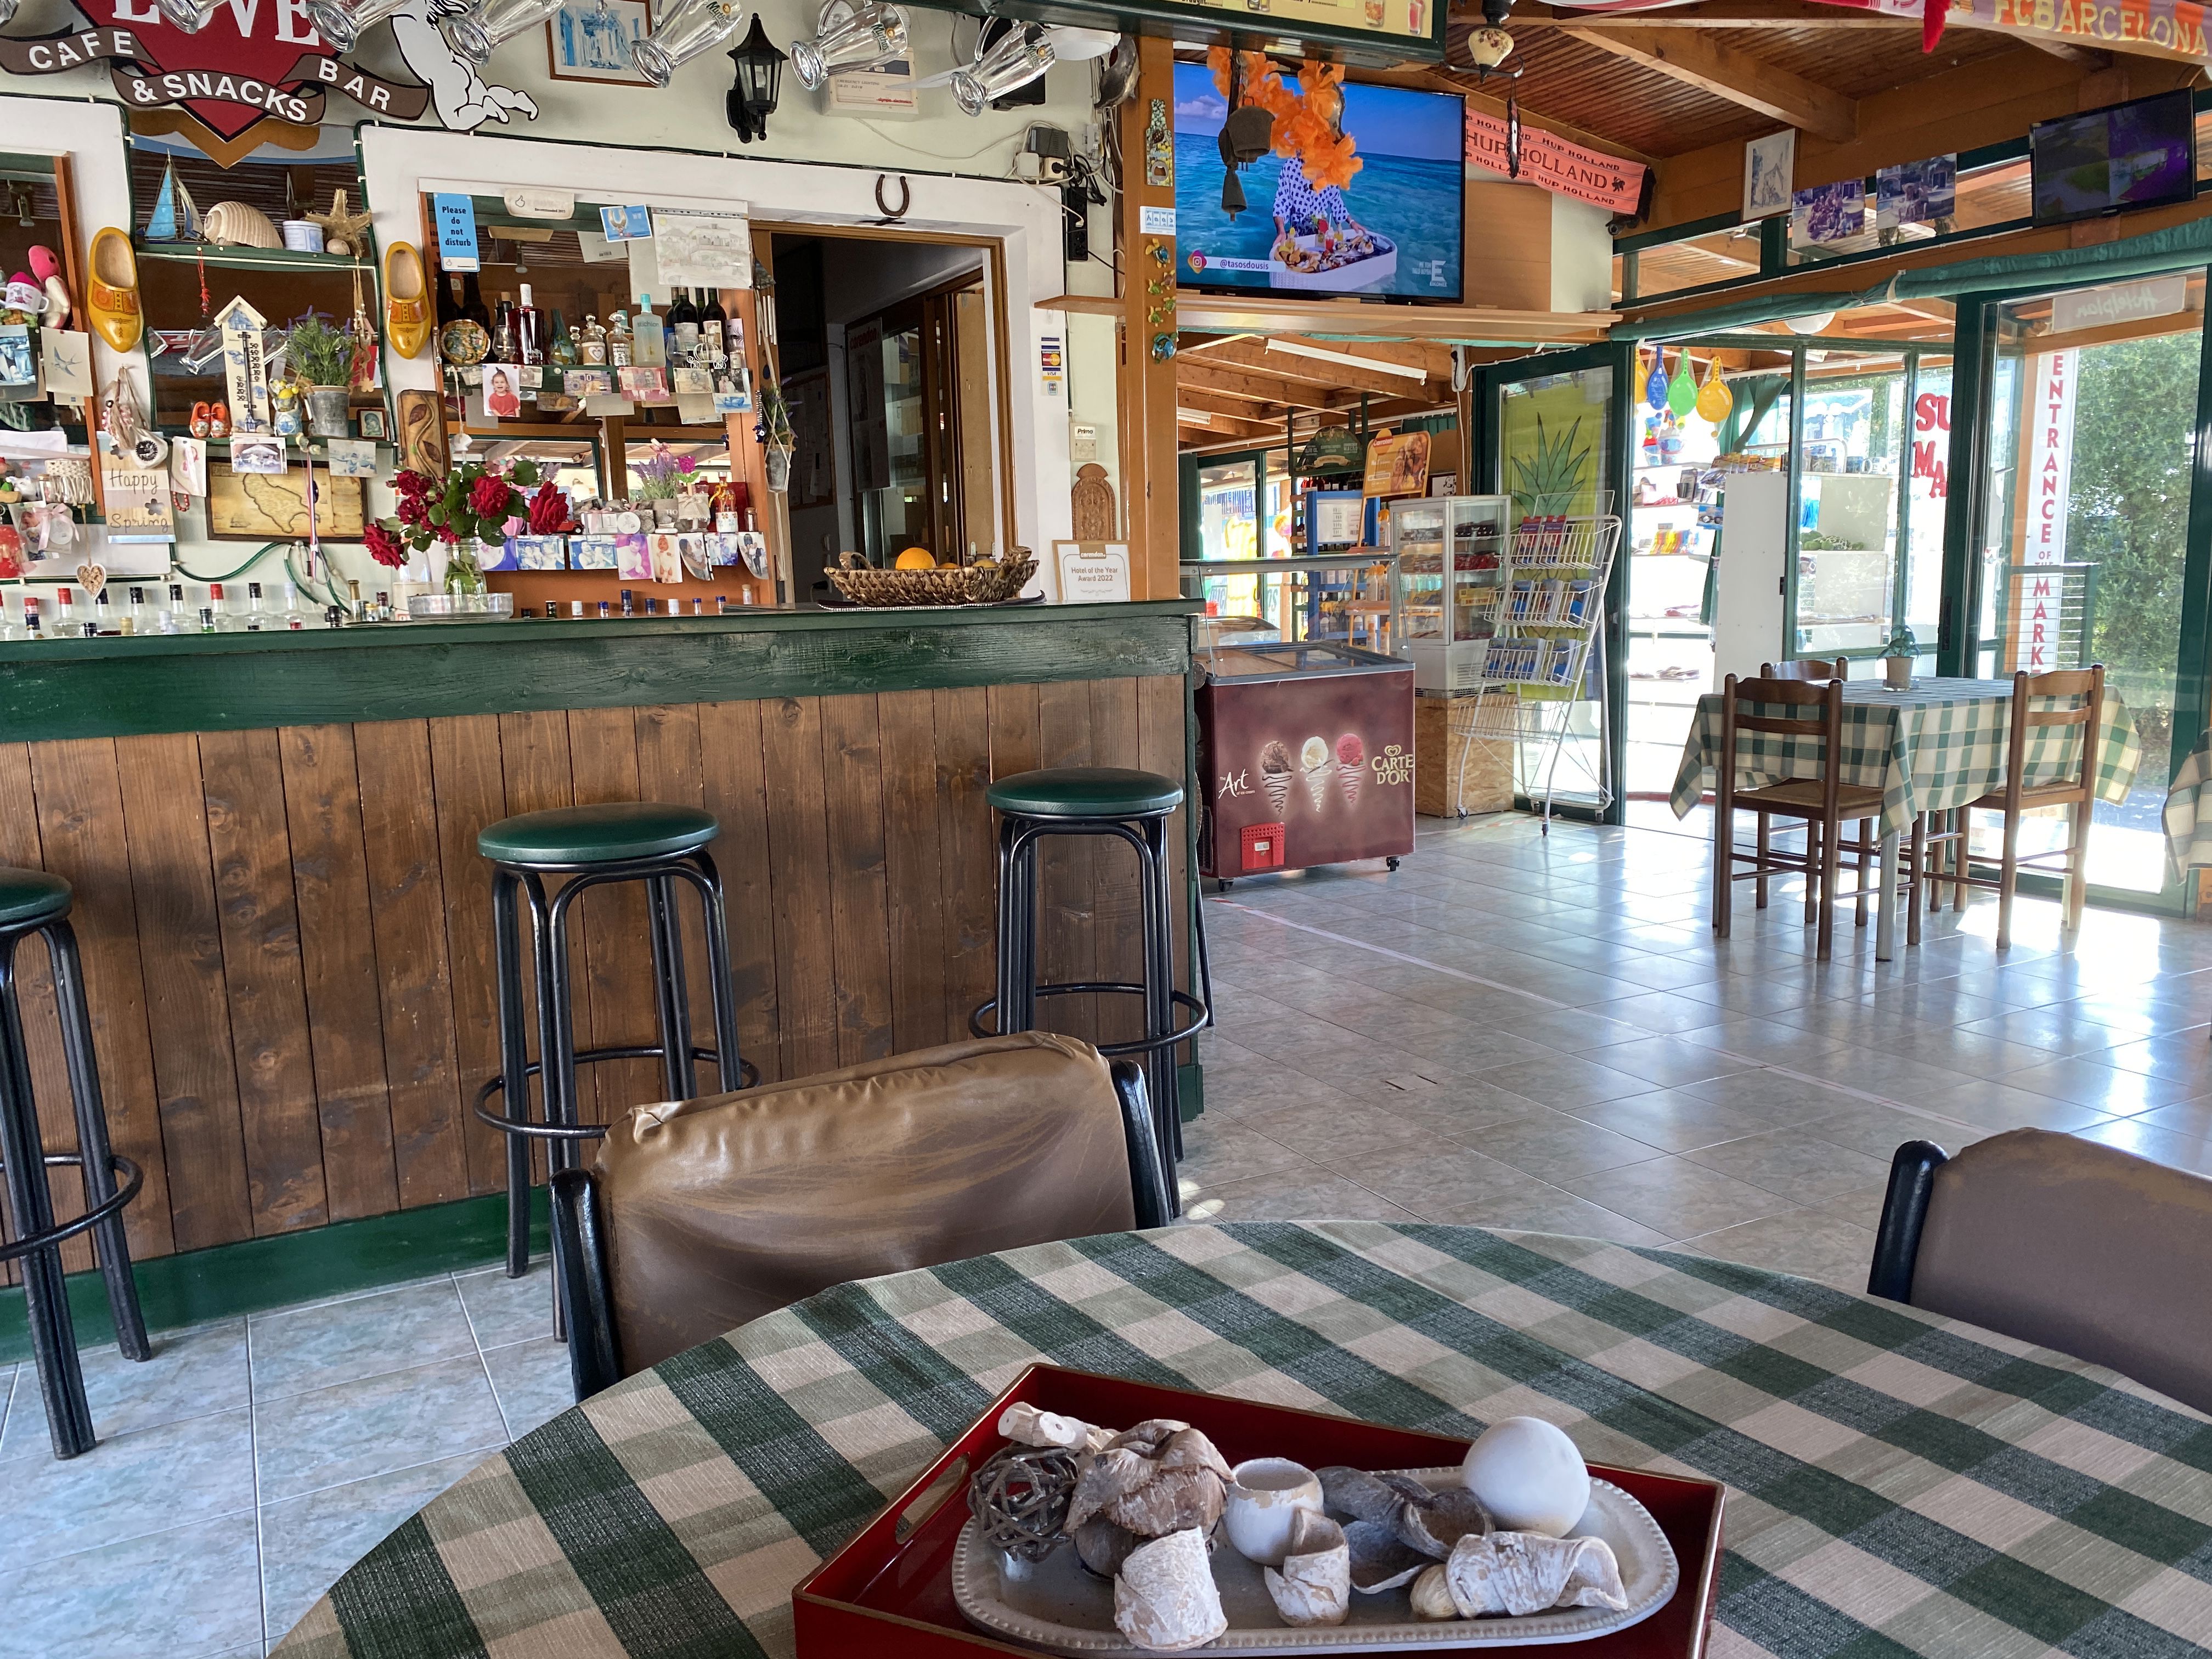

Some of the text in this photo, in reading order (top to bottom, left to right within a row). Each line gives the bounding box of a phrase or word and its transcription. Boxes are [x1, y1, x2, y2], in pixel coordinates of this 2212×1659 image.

[111, 0, 320, 47] LVE
[706, 1, 727, 28] Mythos
[29, 31, 134, 70] CAFE
[132, 73, 308, 122] & SNACKS
[318, 57, 391, 111] BAR
[1466, 128, 1607, 189] HUP HOLLAND
[1477, 120, 1620, 171] HOLLND HUP HOLLAND
[1538, 174, 1559, 187] HUP
[1563, 184, 1615, 205] HOLLAND
[445, 238, 471, 246] disturb
[1220, 259, 1268, 270] @tasosdousis
[584, 373, 592, 381] 10
[2041, 355, 2063, 543] ENTRANCE
[110, 468, 159, 495] Happy
[110, 513, 169, 534] Spring
[2039, 551, 2051, 560] OF
[2031, 577, 2051, 674] MARK
[1372, 754, 1414, 771] CARTE
[1376, 769, 1412, 786] D'OR
[1218, 769, 1249, 799] Art
